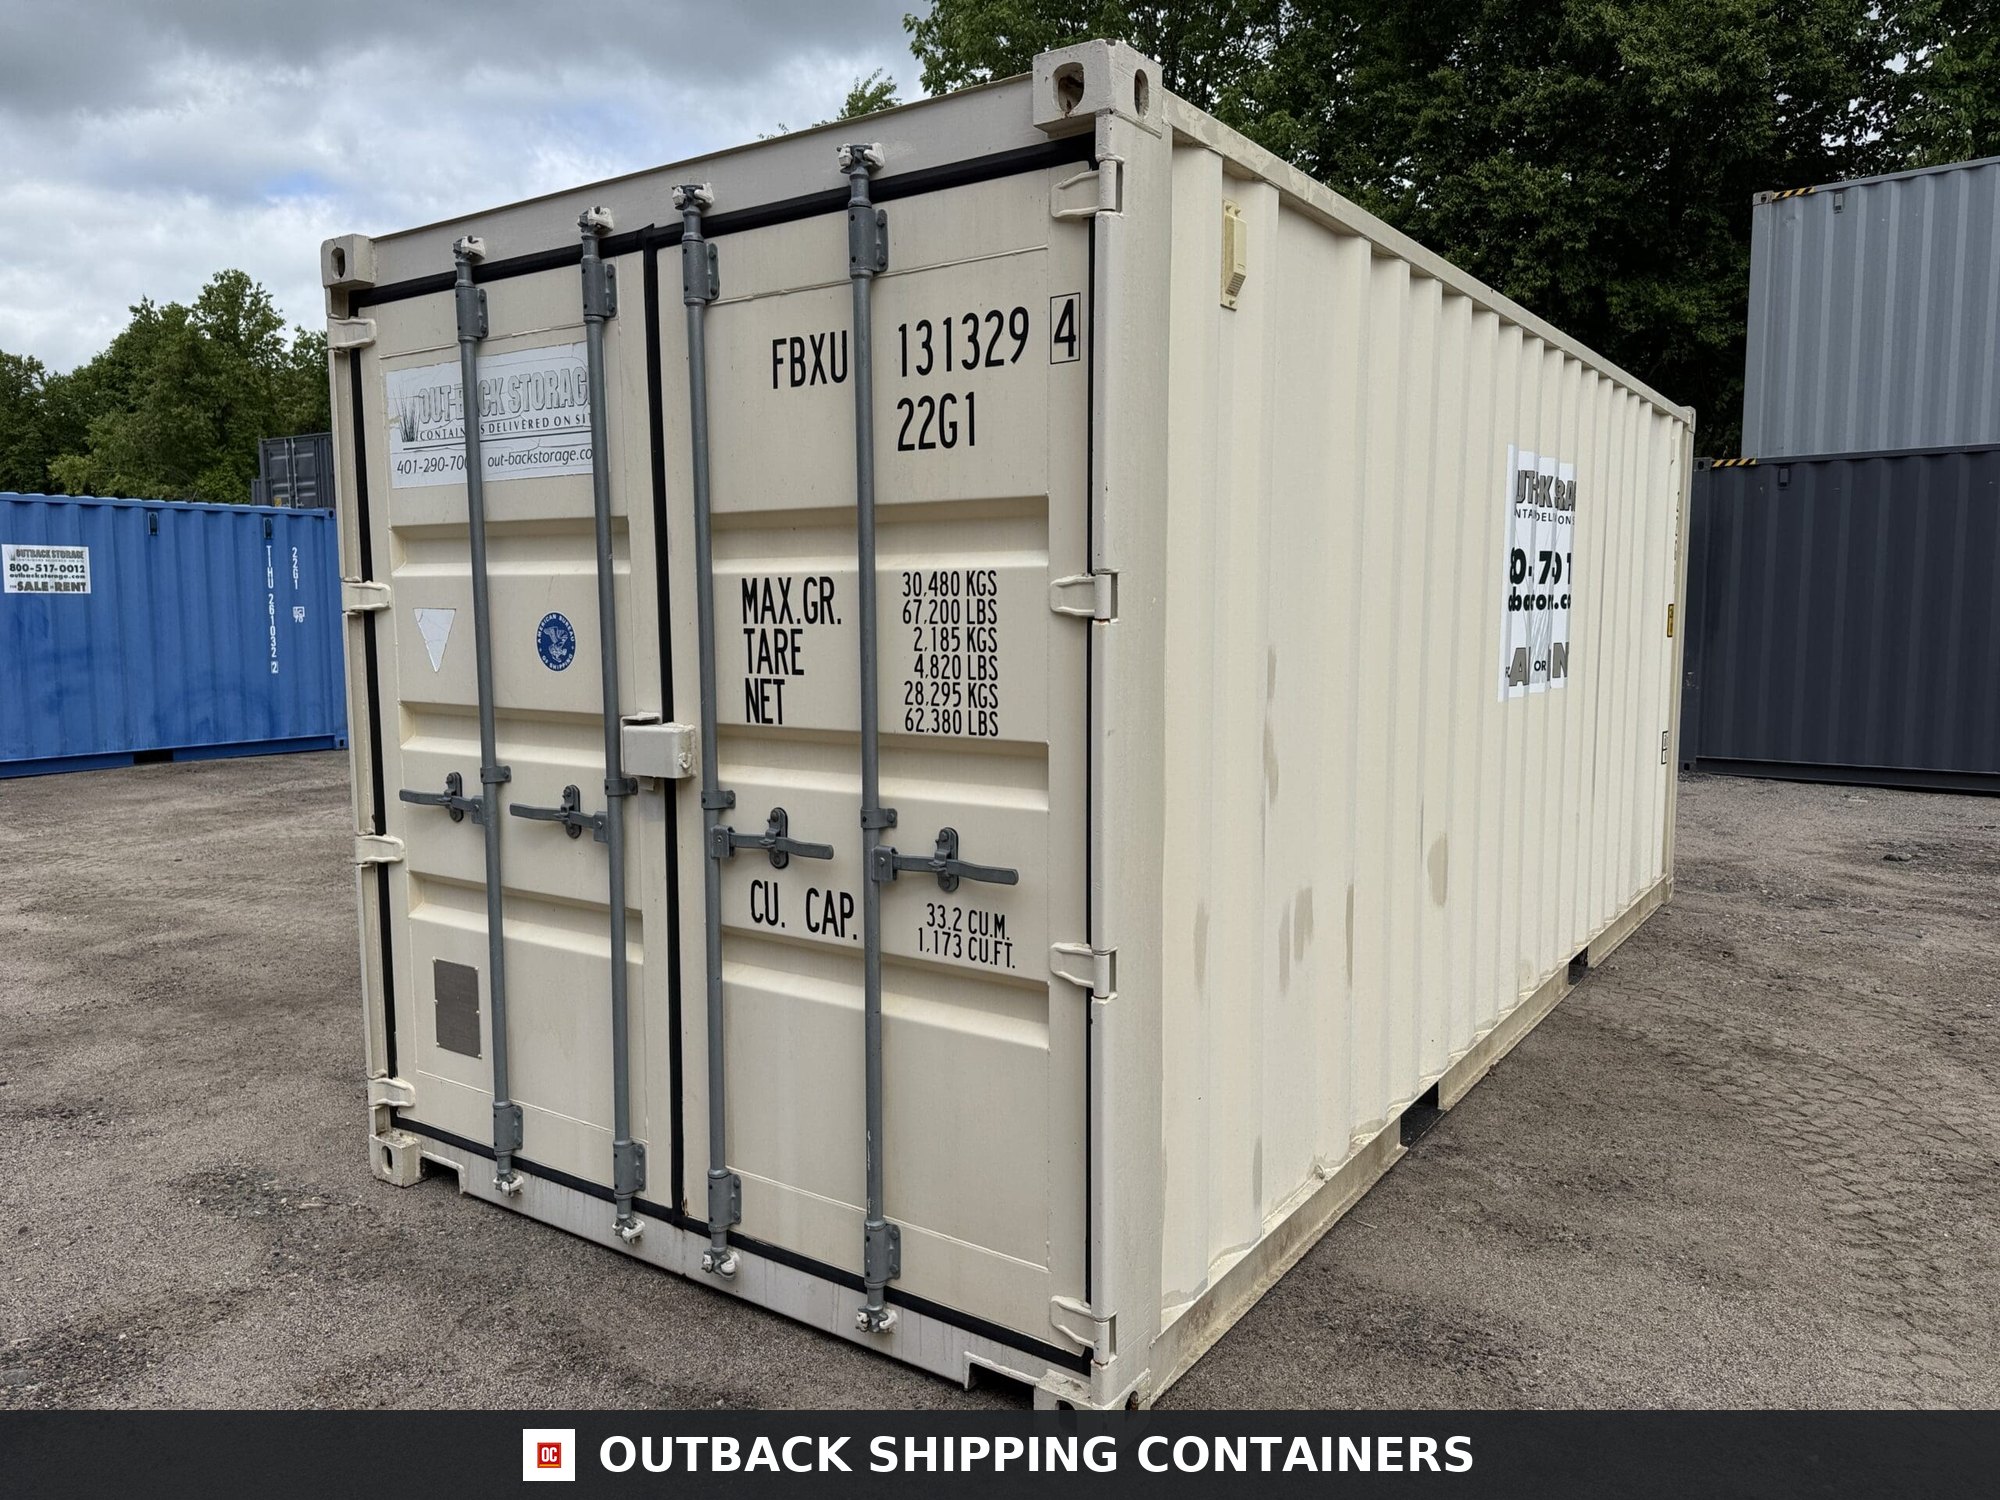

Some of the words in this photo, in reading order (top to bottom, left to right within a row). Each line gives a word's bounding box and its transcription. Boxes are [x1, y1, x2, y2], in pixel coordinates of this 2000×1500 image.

[772, 330, 848, 389] FBXU
[898, 307, 1030, 377] 131329
[1053, 298, 1077, 358] 4
[418, 377, 505, 425] OUT-BCK
[507, 366, 590, 413] STORAG
[488, 417, 549, 434] DELIVERED
[553, 415, 571, 427] ON
[897, 391, 975, 451] 22G1
[397, 454, 468, 475] 401-290-70
[487, 448, 593, 467] out-backstorage.co
[9, 564, 85, 573] 800-517-0012
[16, 549, 51, 558] OUTBACK
[52, 550, 84, 559] STORAGE
[291, 546, 299, 590] 22G1
[17, 581, 49, 591] SALE
[54, 582, 86, 592] RENT
[902, 571, 960, 598] 30,480
[966, 570, 998, 597] KGS
[741, 576, 842, 625] MAX.GR.
[902, 599, 961, 625] 67,200
[966, 599, 998, 625] LBS
[268, 593, 278, 658] 261032
[913, 627, 961, 653] 2,185
[966, 626, 998, 653] KGS
[743, 628, 805, 676] TARE
[271, 661, 279, 674] 2
[913, 654, 961, 680] 4,820
[967, 655, 999, 681] LBS
[745, 678, 785, 725] NET
[904, 681, 962, 708] 28,295
[967, 683, 999, 709] KGS
[904, 708, 963, 735] 62,380
[968, 710, 999, 737] LBS
[750, 879, 786, 929] CU.
[805, 887, 858, 941] CAP.
[926, 902, 963, 933] 33.2
[968, 909, 1011, 941] CU.M.
[918, 927, 963, 959] 1,173
[968, 936, 1016, 969] CU.FT.
